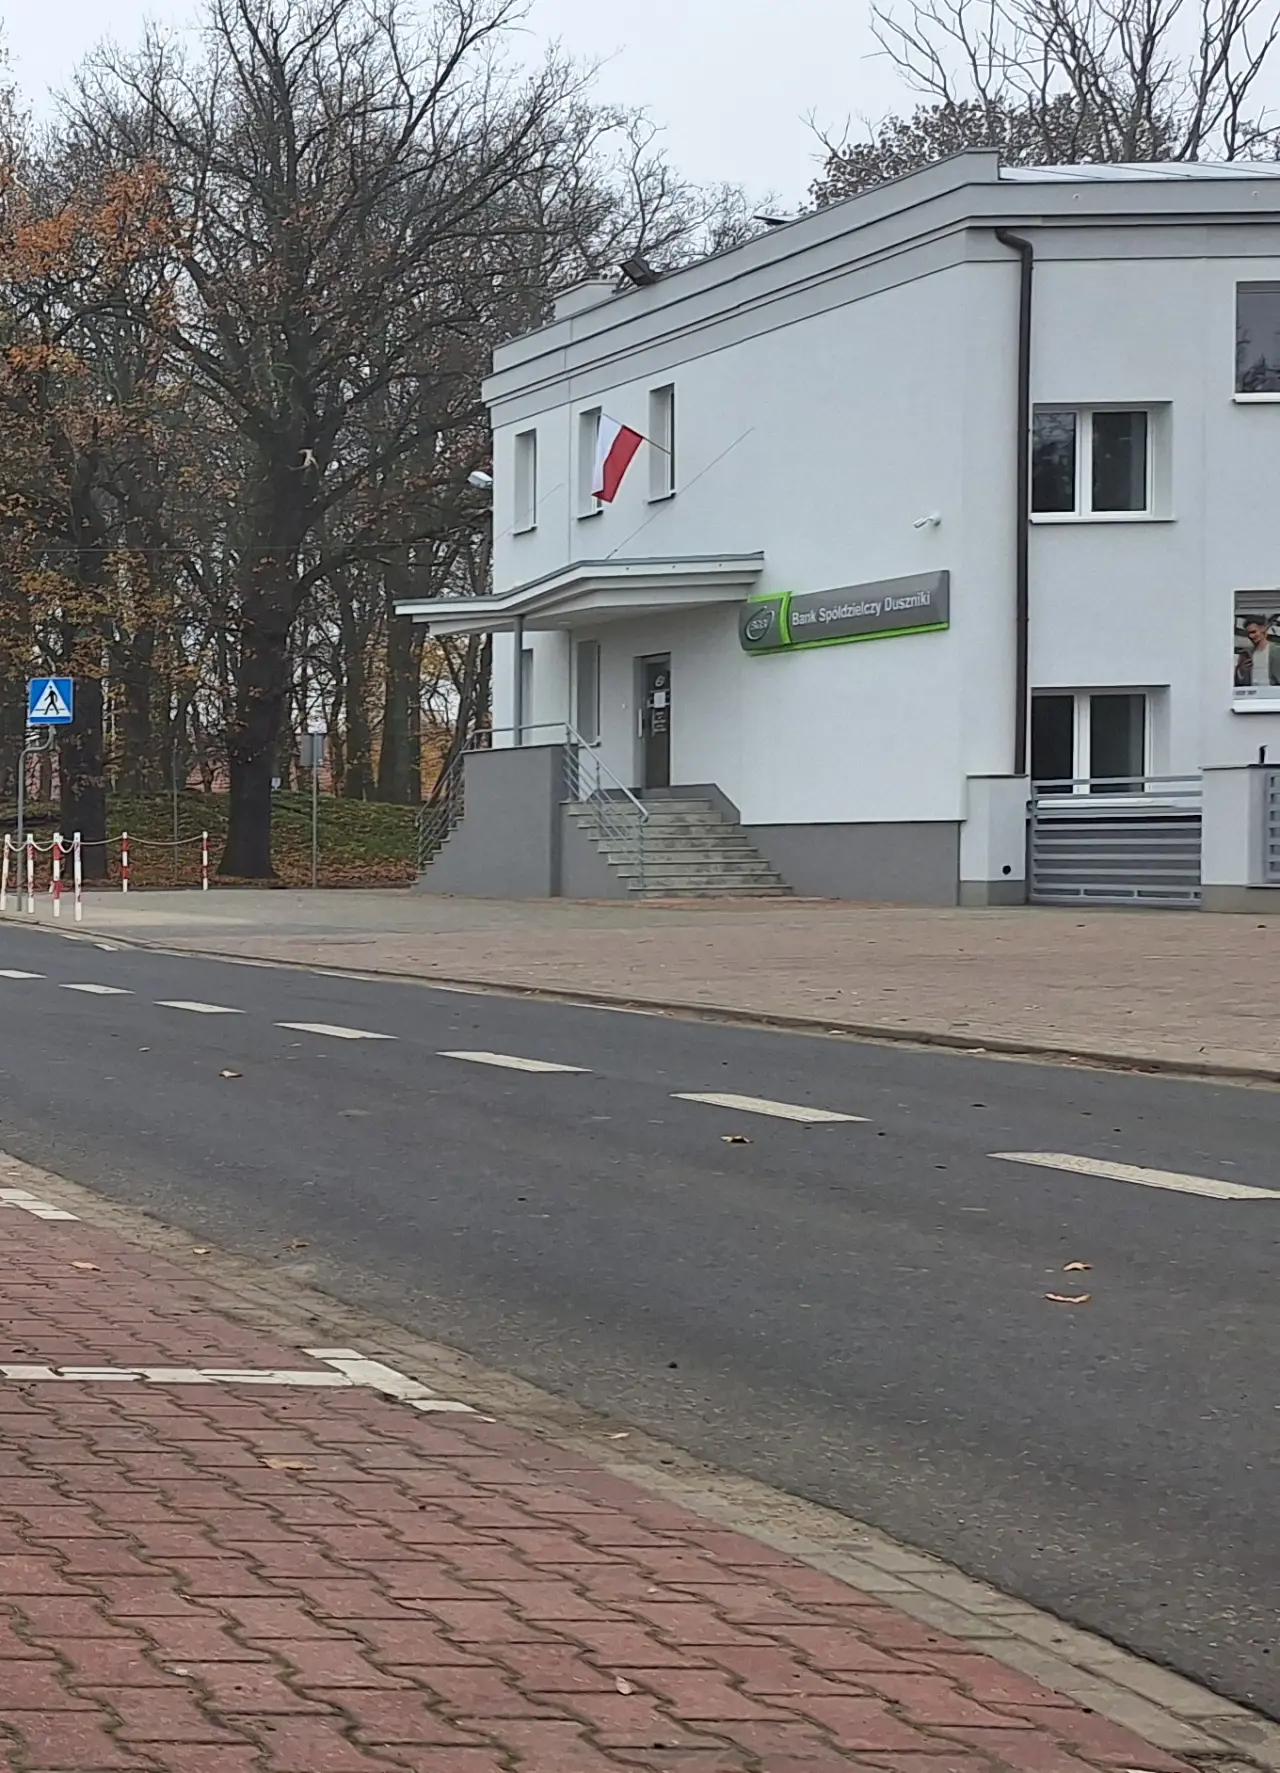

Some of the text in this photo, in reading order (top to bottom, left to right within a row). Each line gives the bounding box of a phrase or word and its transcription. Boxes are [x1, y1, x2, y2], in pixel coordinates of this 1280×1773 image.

[792, 590, 931, 626] Bank Spółdzielczy Duszniki
